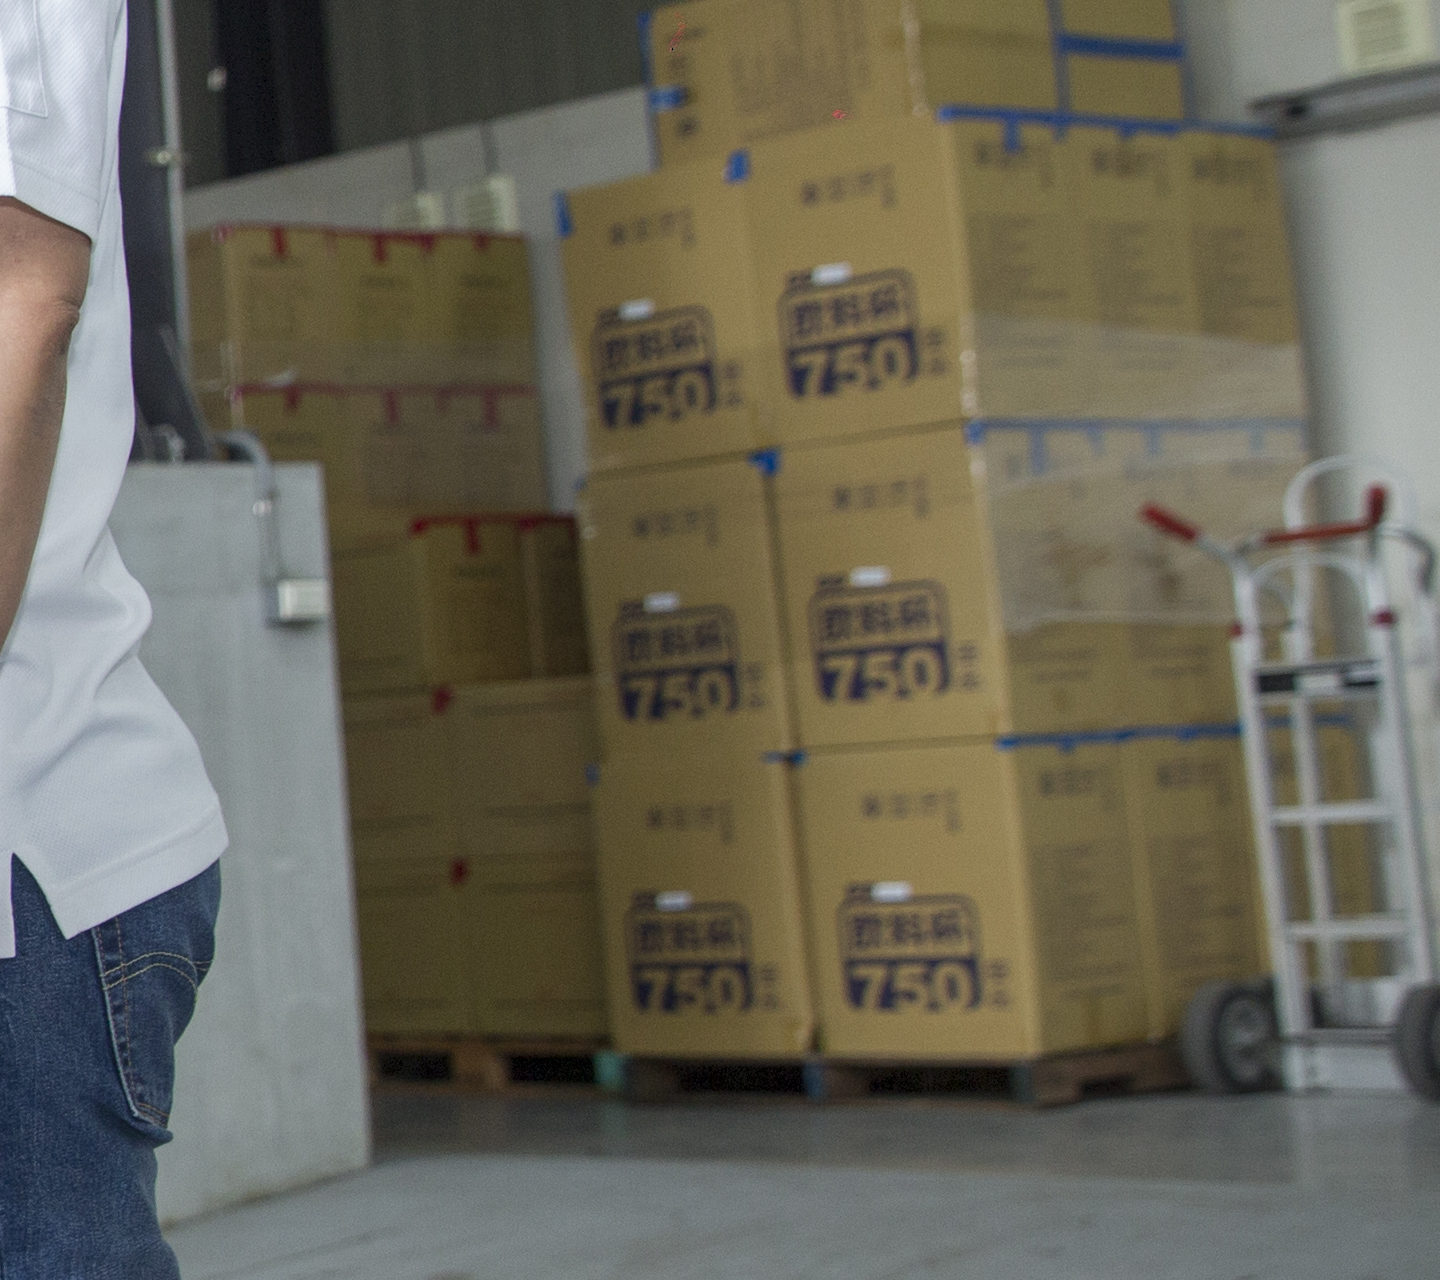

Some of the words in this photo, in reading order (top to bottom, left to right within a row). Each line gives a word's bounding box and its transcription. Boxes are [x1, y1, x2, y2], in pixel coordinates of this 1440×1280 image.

[791, 339, 907, 396] 750
[608, 372, 707, 424] 750
[628, 673, 727, 720] 750
[824, 649, 939, 700] 750
[640, 967, 741, 1012] 750
[850, 964, 969, 1011] 750
